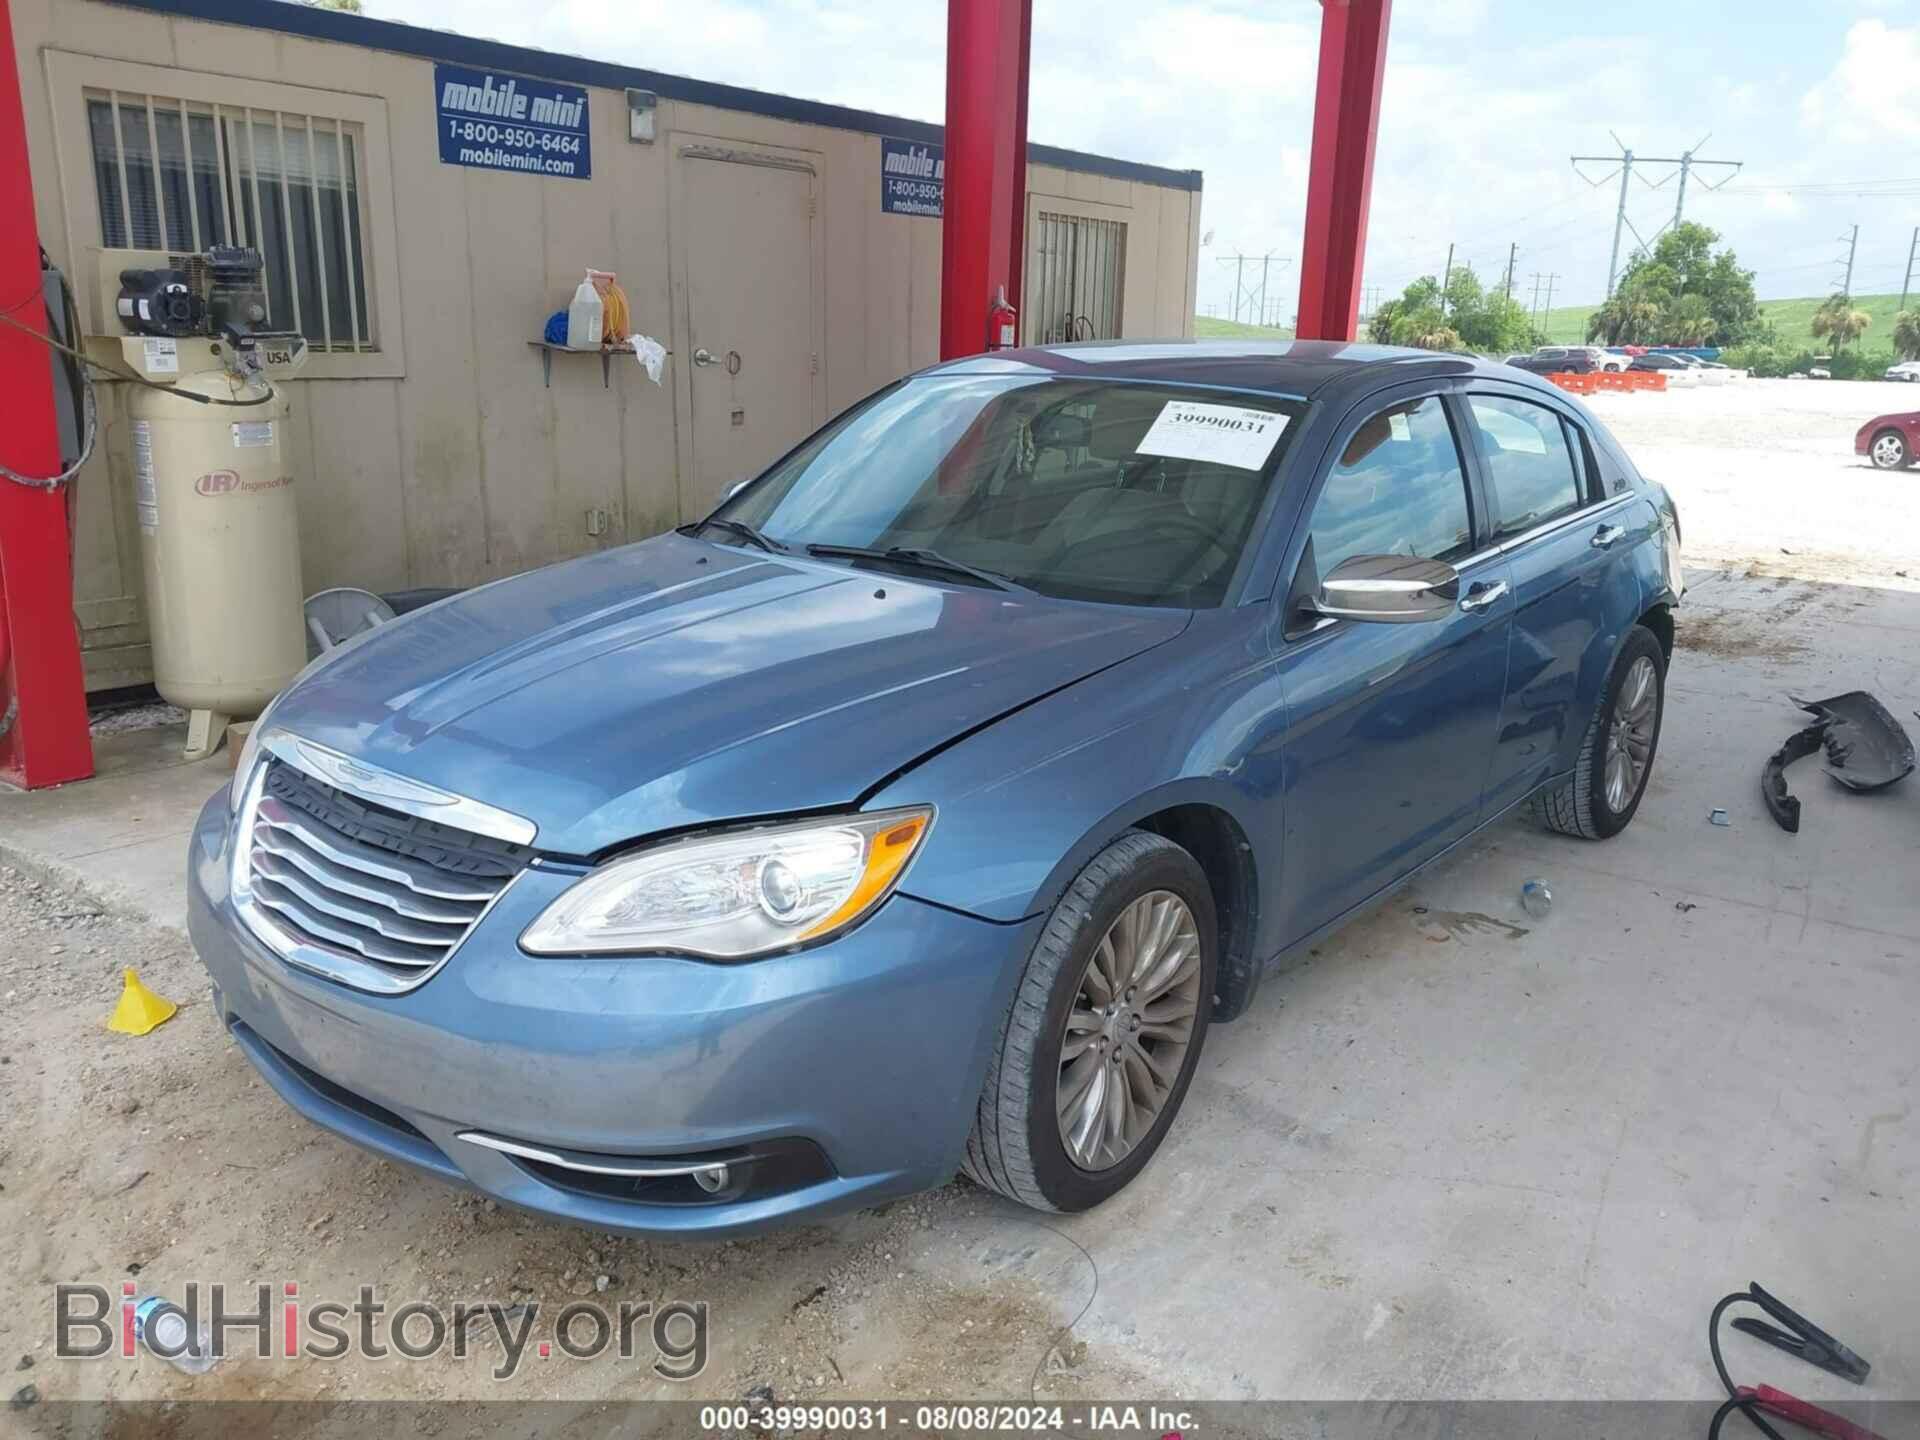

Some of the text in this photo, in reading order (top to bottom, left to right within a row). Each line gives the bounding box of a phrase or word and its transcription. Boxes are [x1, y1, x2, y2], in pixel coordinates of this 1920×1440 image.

[441, 76, 584, 128] mobile mini
[449, 120, 580, 155] 1-800-950-6464
[459, 148, 575, 175] mobilemini.com
[885, 146, 934, 177] mobile
[888, 180, 944, 200] 1-800-950-6
[266, 351, 291, 364] USA
[1168, 412, 1266, 434] 39990031
